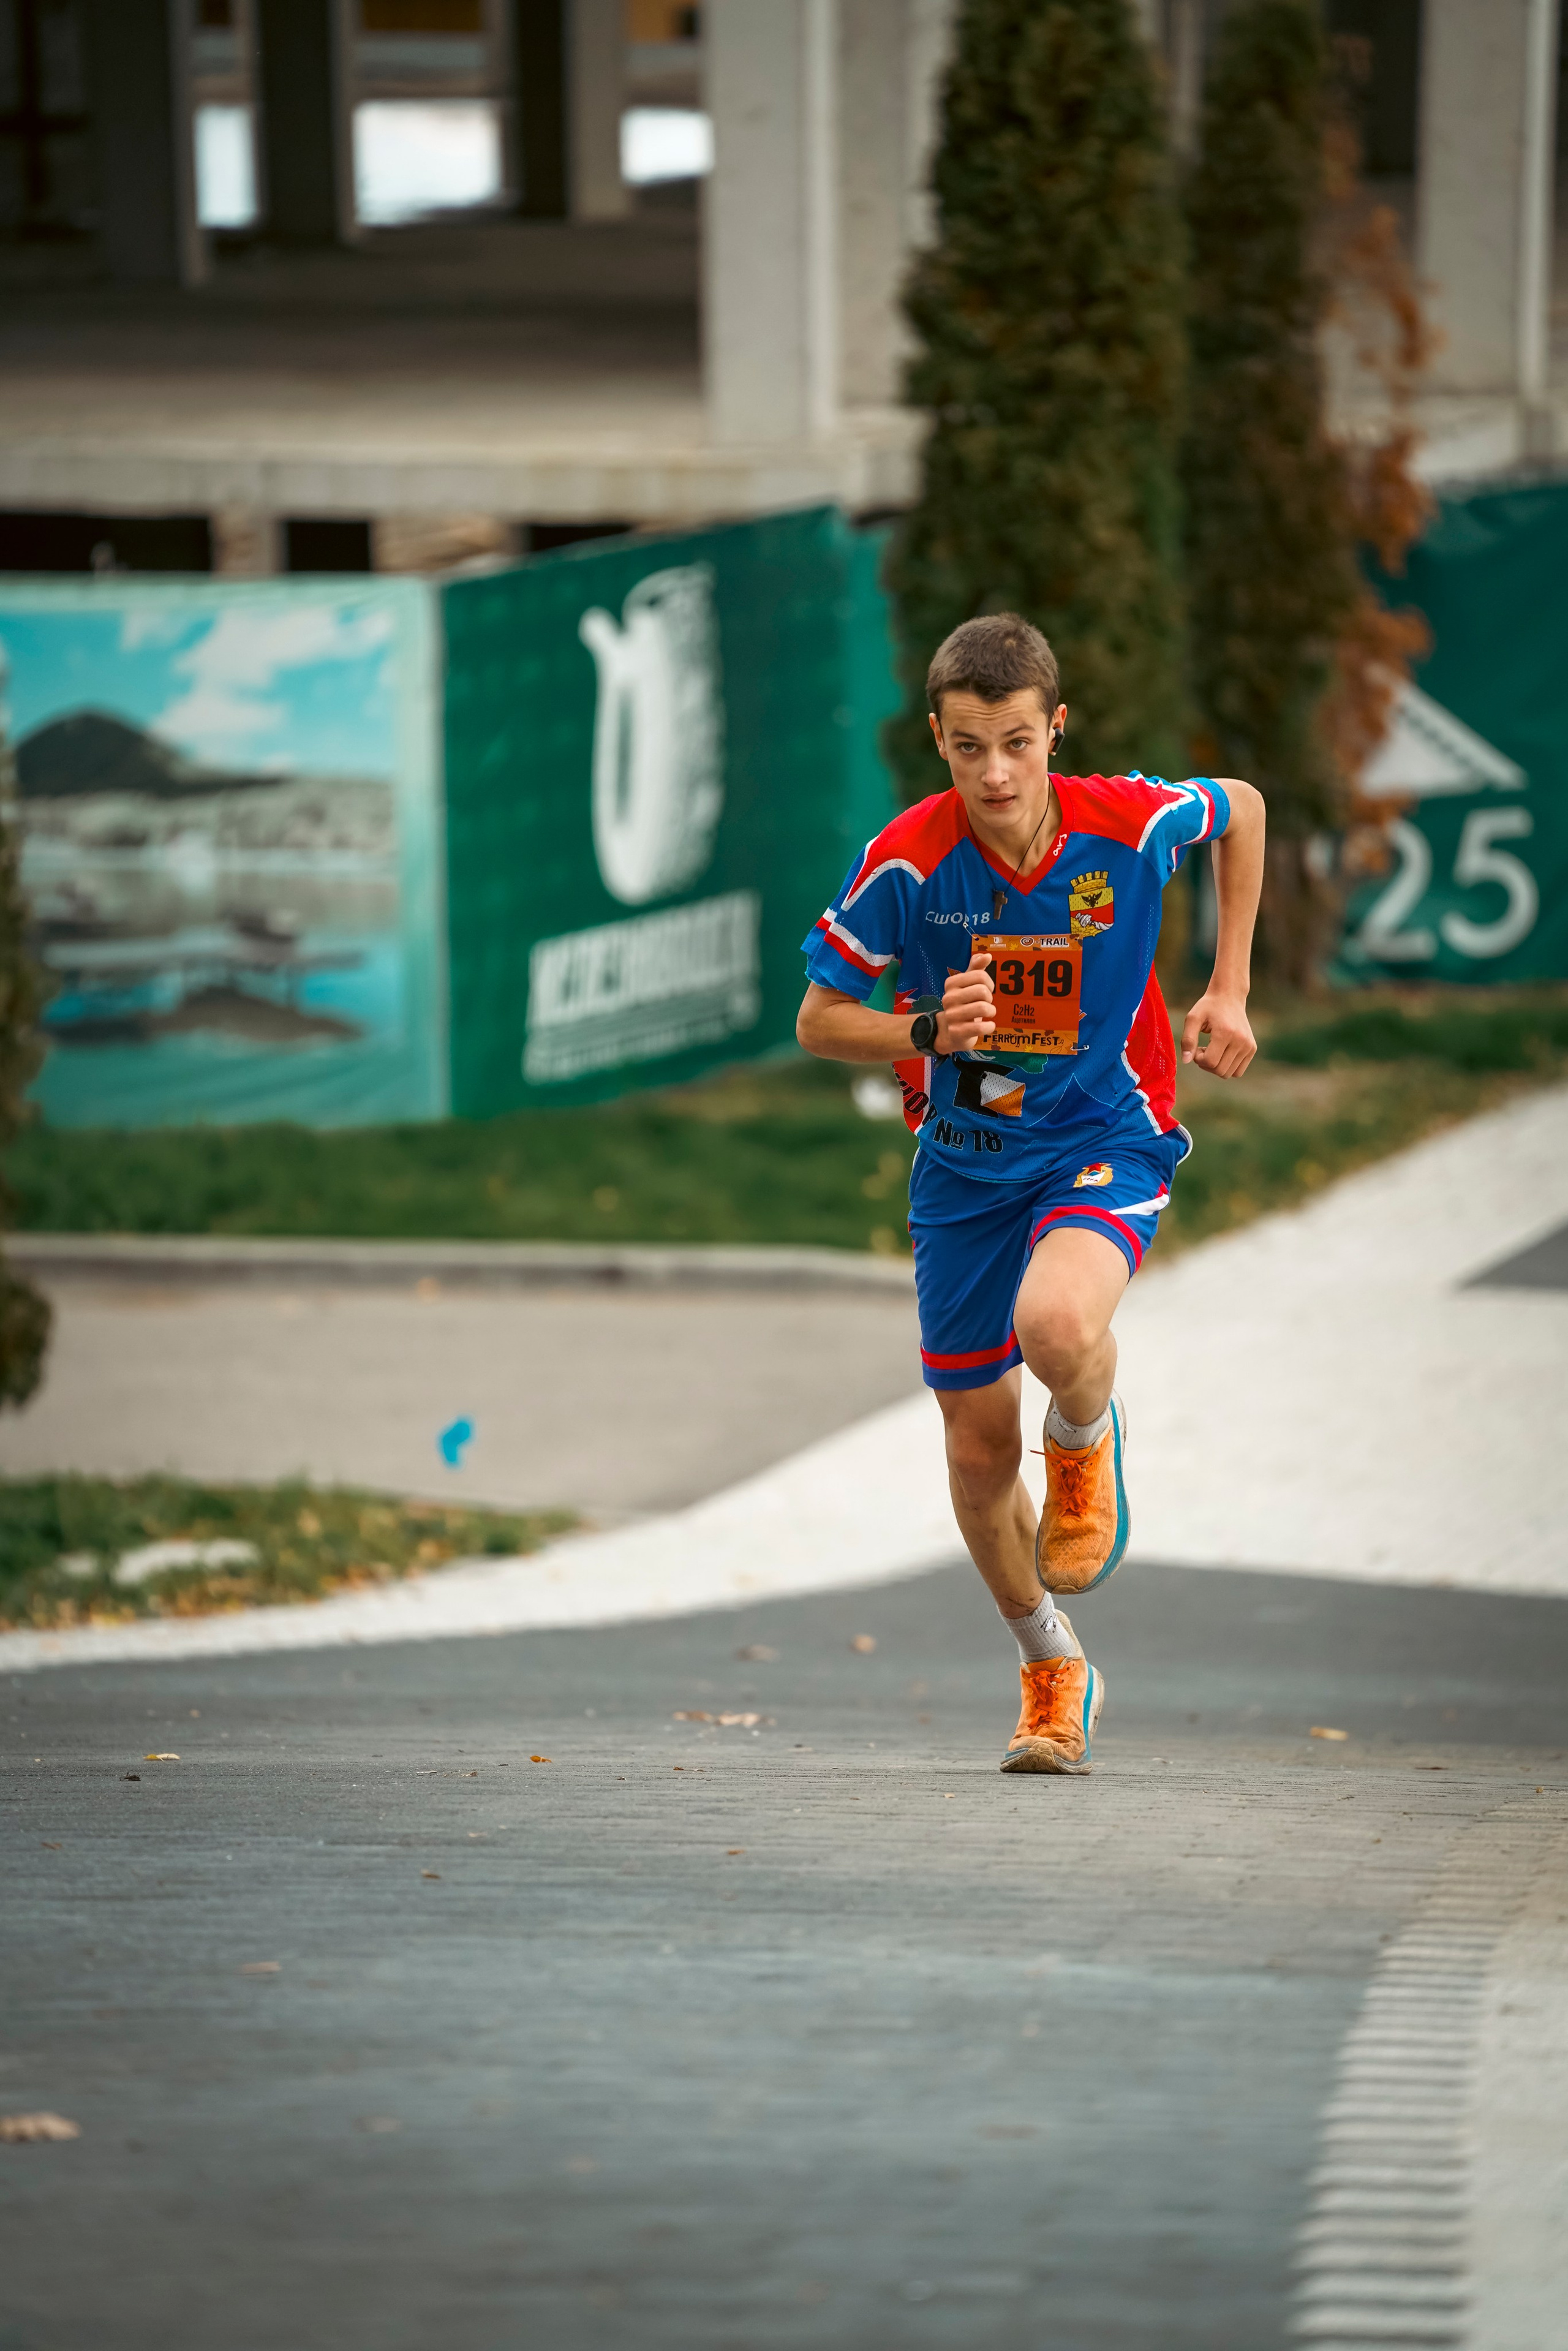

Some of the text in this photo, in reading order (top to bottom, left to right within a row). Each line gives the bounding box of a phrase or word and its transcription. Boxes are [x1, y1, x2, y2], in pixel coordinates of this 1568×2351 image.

[972, 911, 990, 926] 18
[1013, 1003, 1035, 1016] C2H2
[968, 1129, 1003, 1154] 18
